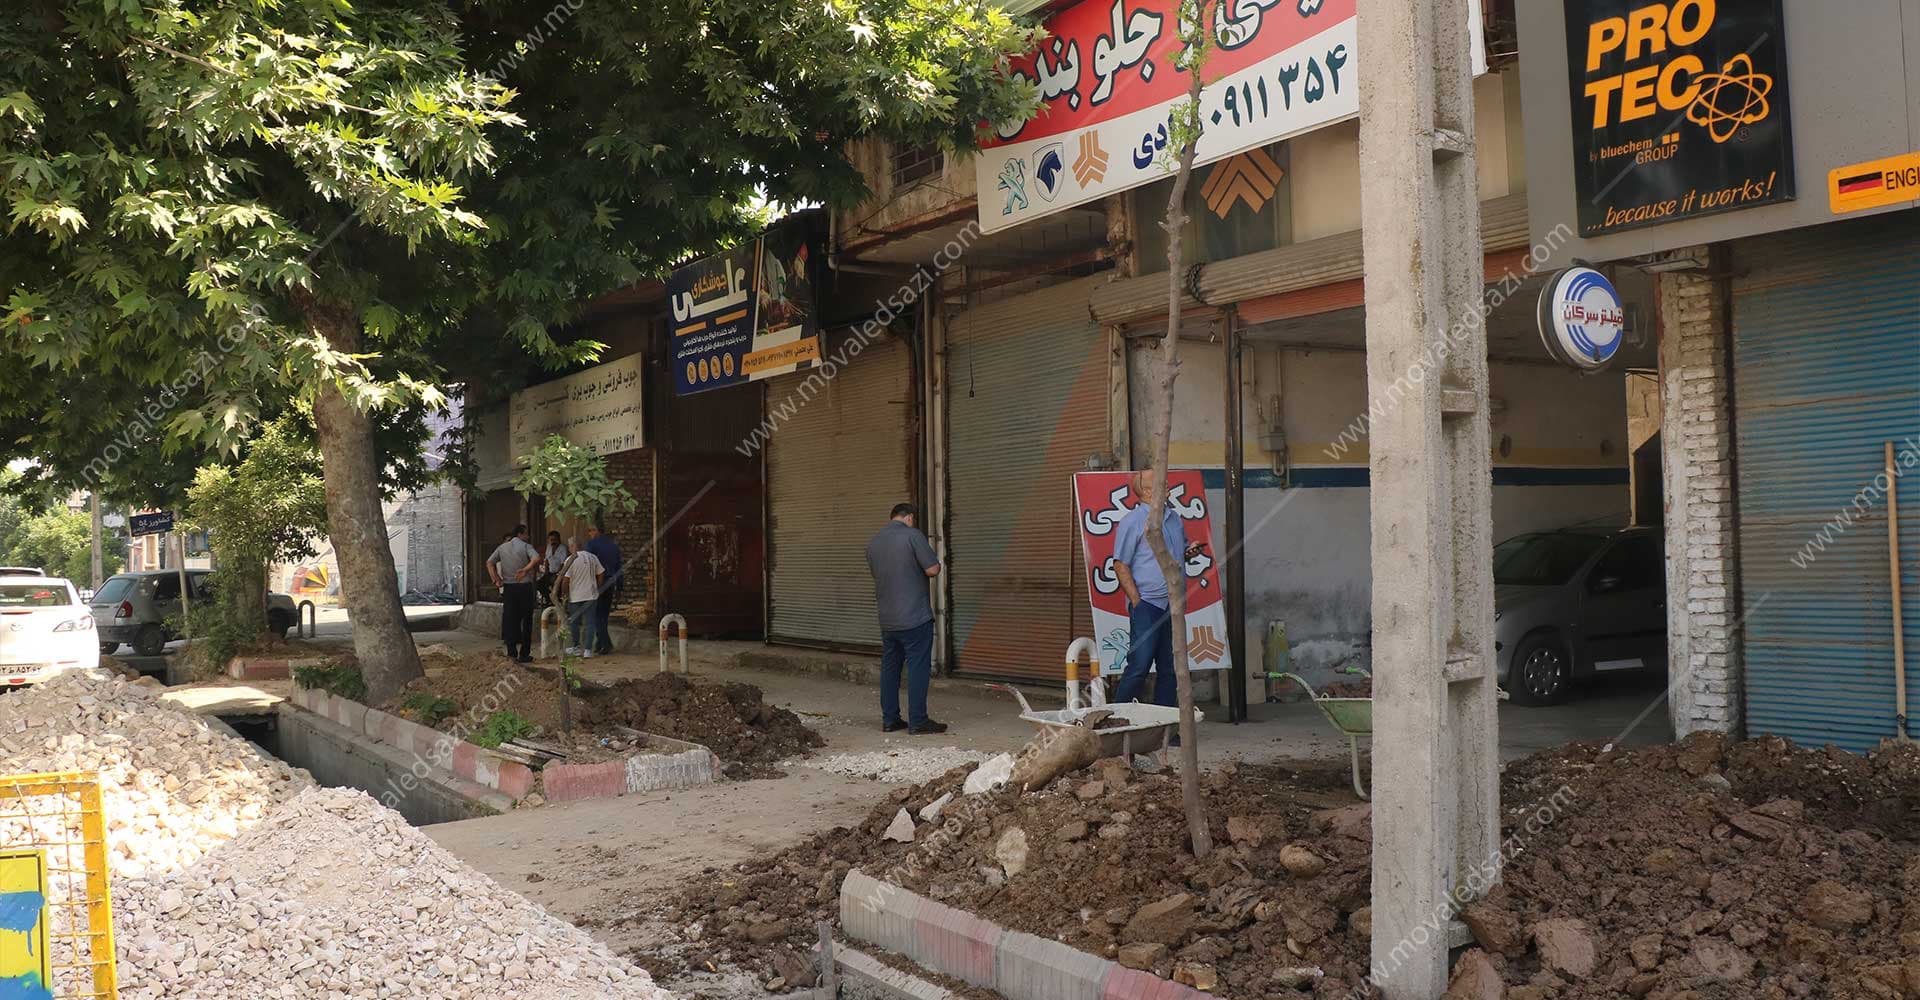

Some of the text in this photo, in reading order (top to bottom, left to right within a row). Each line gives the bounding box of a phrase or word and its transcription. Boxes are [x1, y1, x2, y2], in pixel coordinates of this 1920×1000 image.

[1090, 0, 1164, 105] جلو
[1586, 0, 1717, 72] PRO
[1210, 44, 1348, 127] ۰۹۱۱ ۳۵۴
[1584, 54, 1704, 129] TEC
[1600, 138, 1653, 160] bluechem
[1635, 143, 1679, 165] GROUP
[1681, 188, 1697, 213] it
[1700, 171, 1777, 210] works!
[671, 258, 749, 323] علی
[690, 270, 728, 299] جوشکاری
[1563, 304, 1625, 328] فیلتر سرکان
[1083, 482, 1207, 536] مککی
